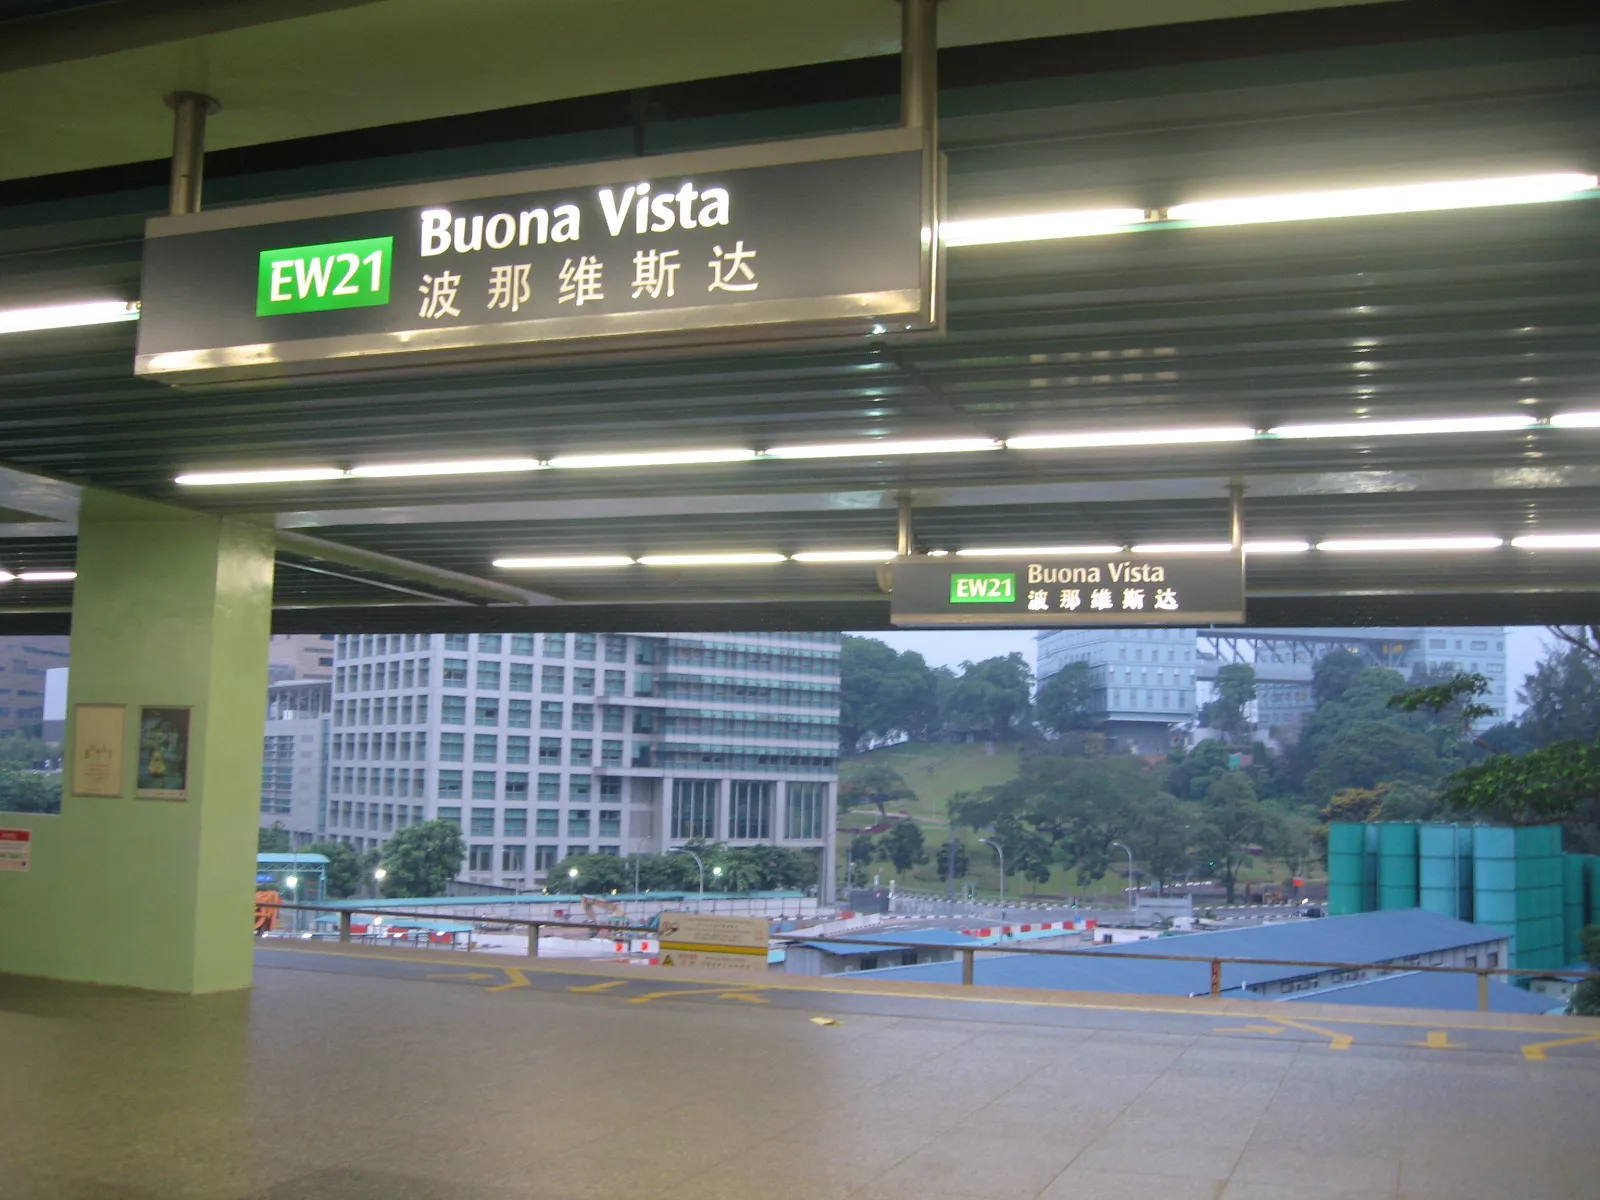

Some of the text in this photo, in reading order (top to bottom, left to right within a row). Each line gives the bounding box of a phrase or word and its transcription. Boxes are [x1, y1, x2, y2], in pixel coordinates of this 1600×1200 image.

[420, 182, 730, 257] Buona Vista
[269, 250, 383, 302] EW21
[418, 241, 759, 319] 波那维斯达
[956, 578, 1012, 597] EW21
[1027, 561, 1165, 584] Buona Vista
[1027, 588, 1179, 611] 波那维斯达
